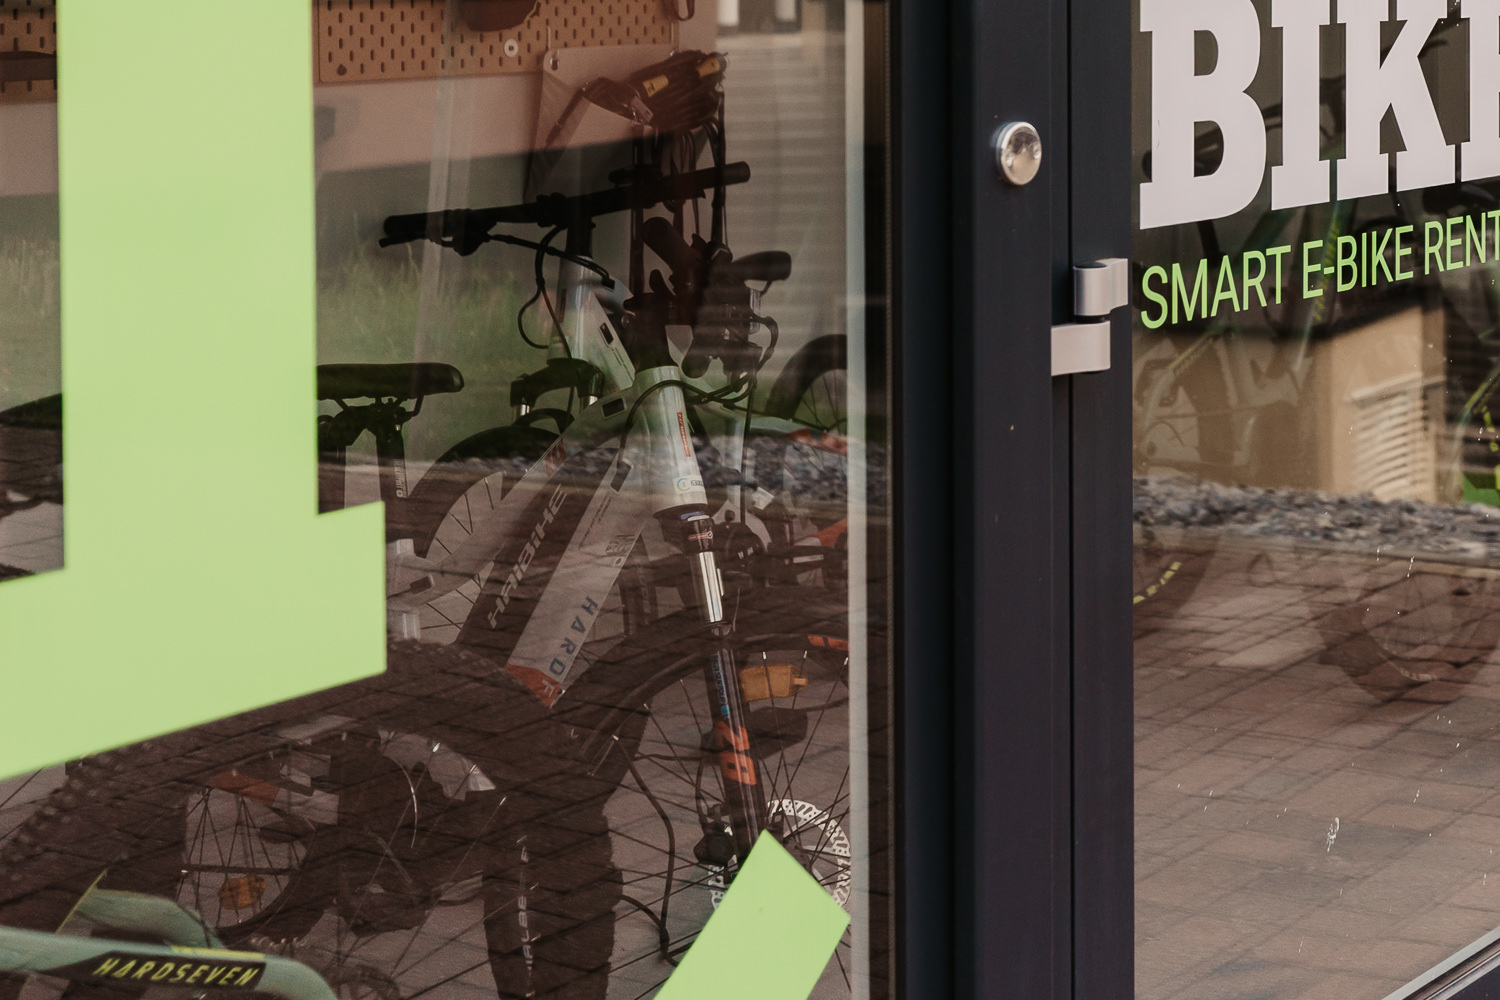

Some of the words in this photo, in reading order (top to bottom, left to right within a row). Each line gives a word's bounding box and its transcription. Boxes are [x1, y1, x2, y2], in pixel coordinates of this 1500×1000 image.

[1140, 244, 1292, 330] SMART
[1302, 224, 1415, 299] E-BIKE
[93, 957, 261, 986] HARDSEVEN
